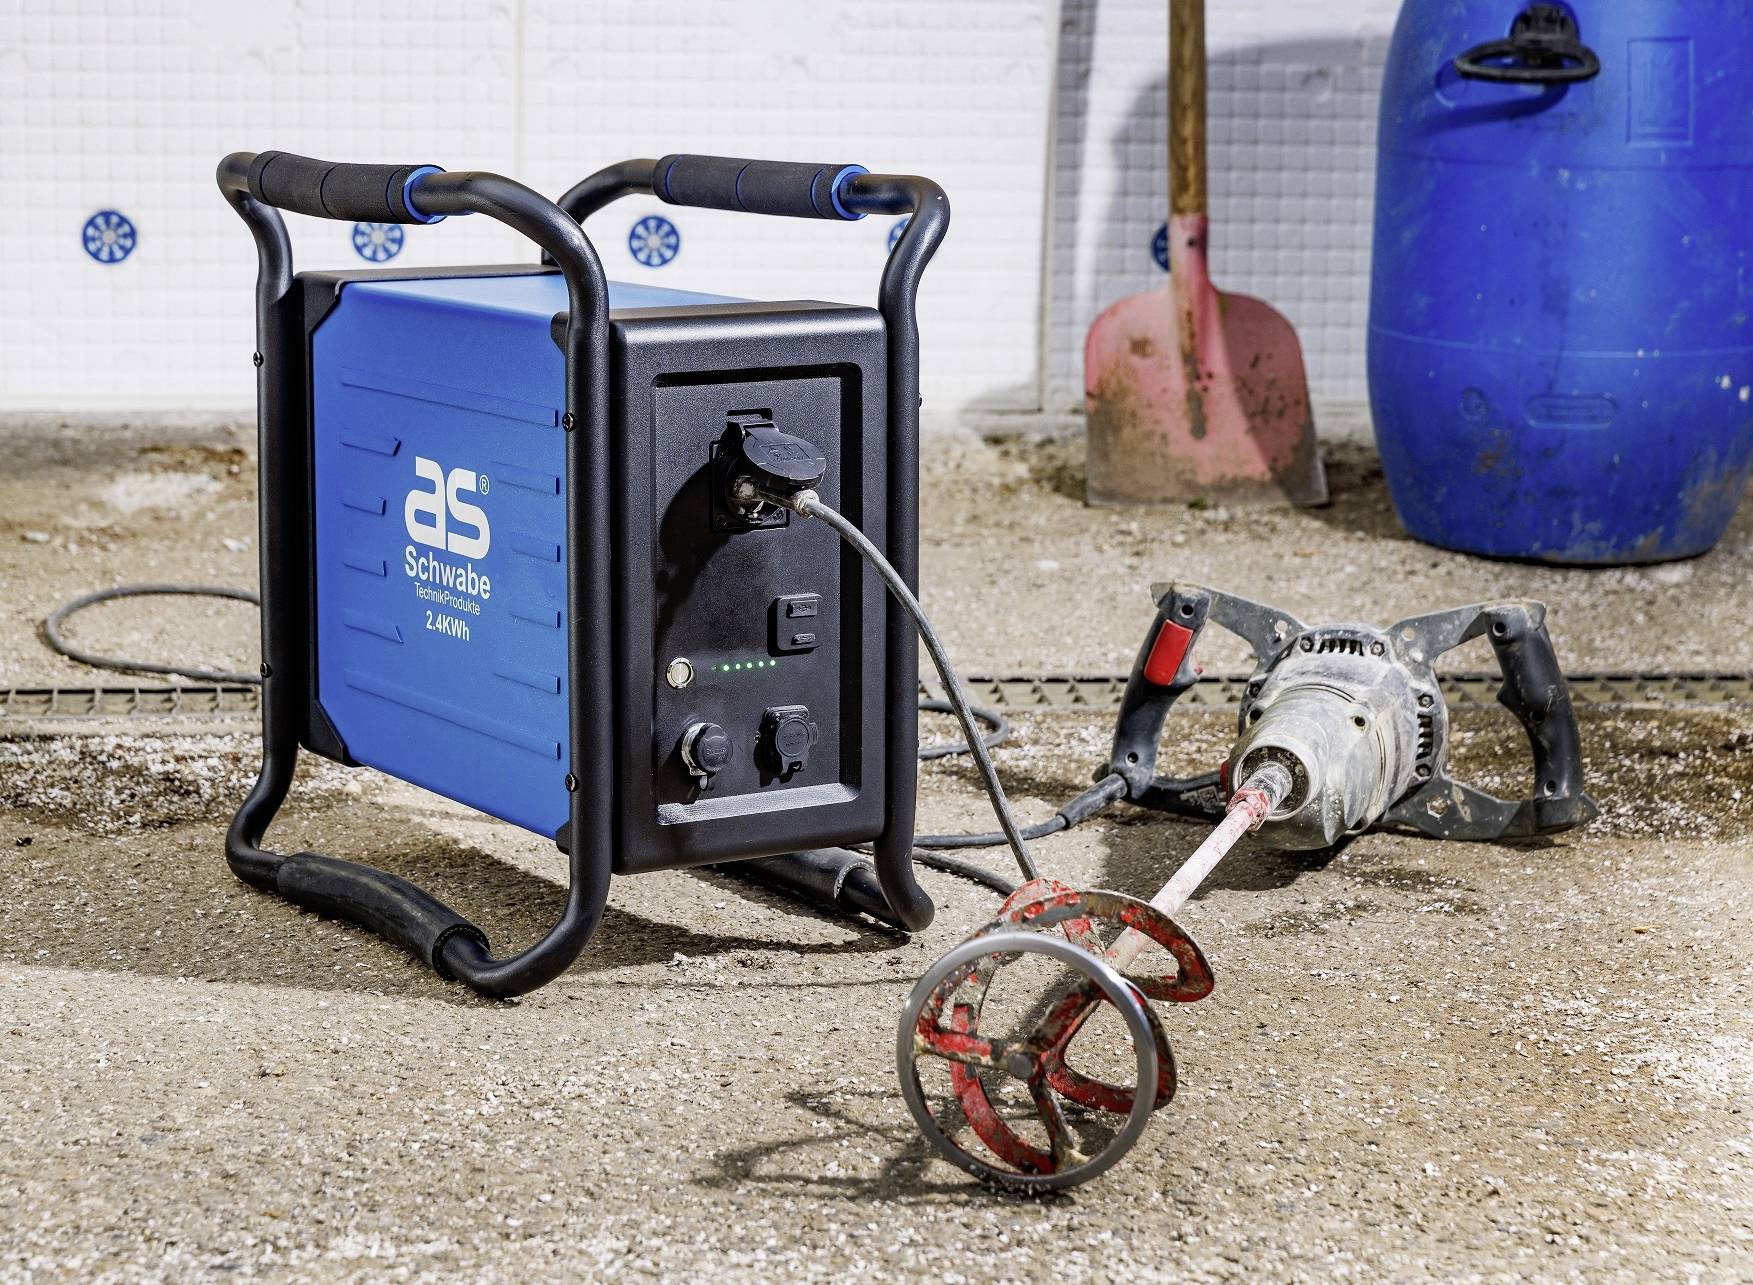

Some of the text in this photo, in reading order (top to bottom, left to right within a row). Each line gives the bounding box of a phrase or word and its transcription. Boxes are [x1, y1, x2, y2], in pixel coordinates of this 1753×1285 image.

[404, 545, 491, 600] Schwabe
[414, 582, 481, 616] TechnikProdukte
[426, 610, 470, 641] 2.4KWh
